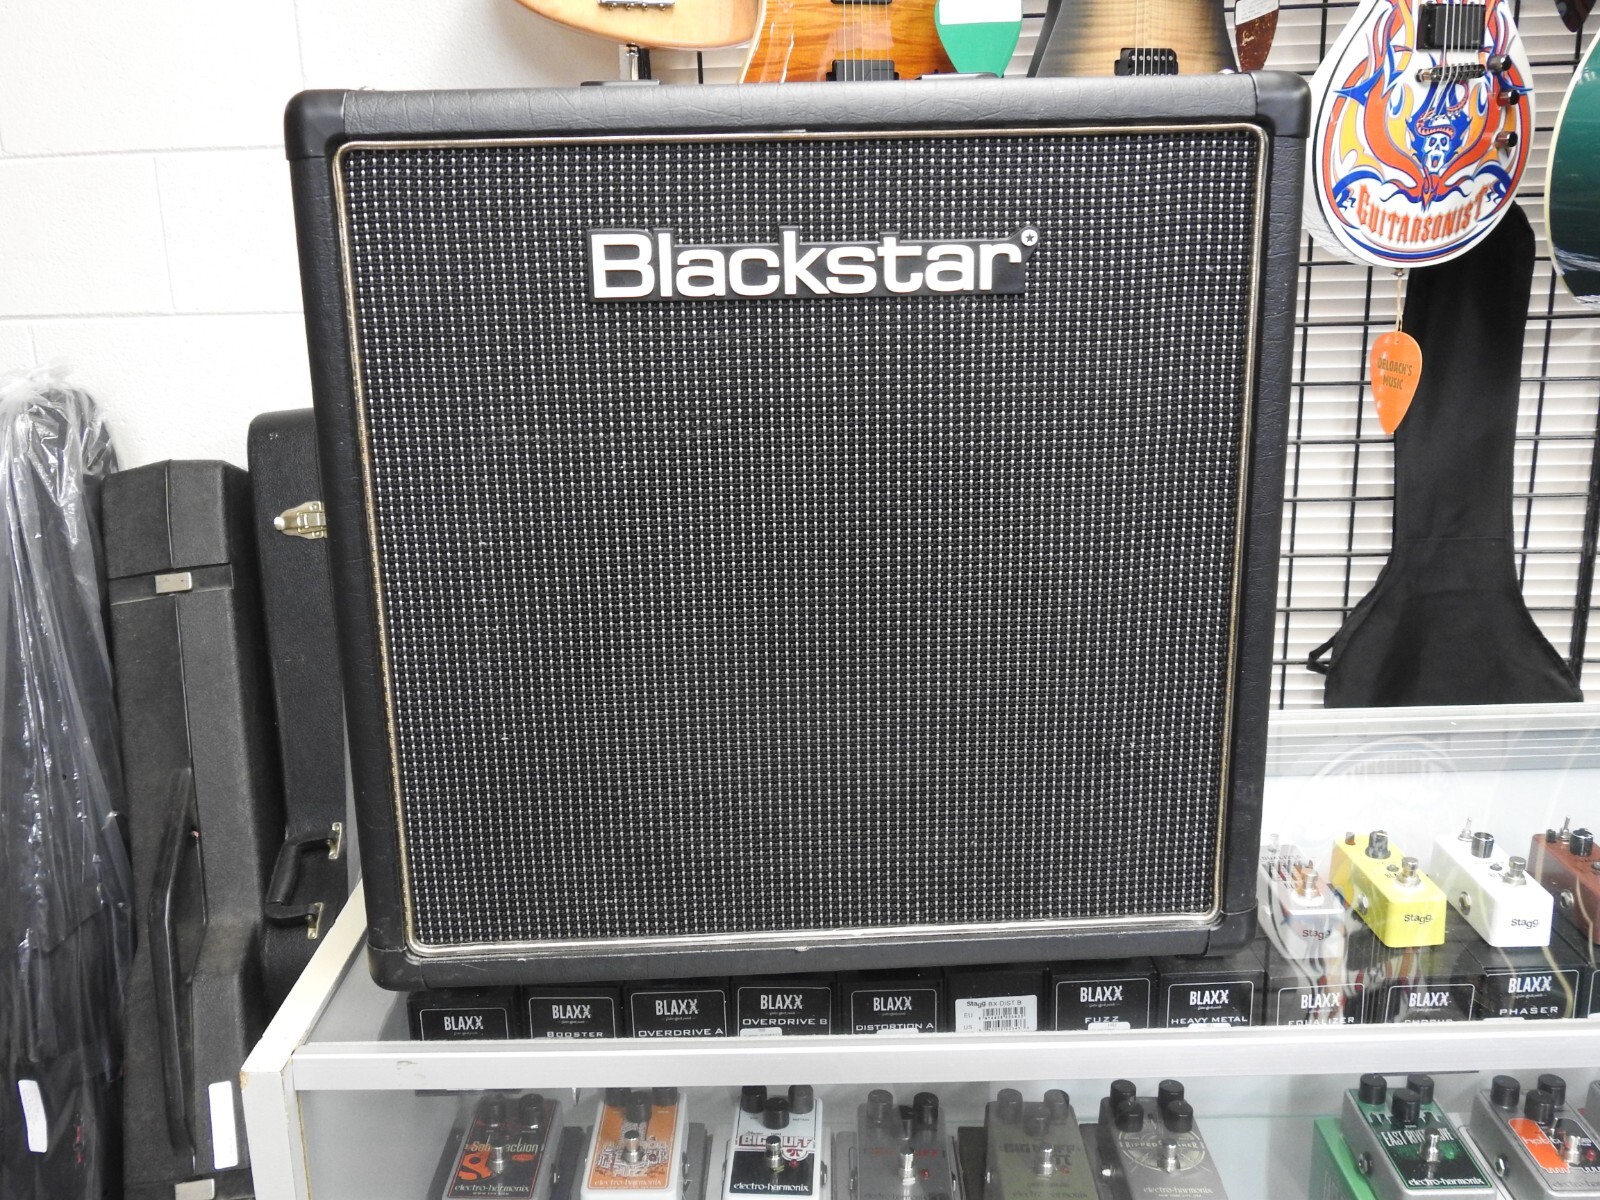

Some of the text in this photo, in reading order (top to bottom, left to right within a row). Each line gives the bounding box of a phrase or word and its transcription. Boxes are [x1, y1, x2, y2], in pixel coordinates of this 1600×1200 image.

[1356, 184, 1488, 243] GUITARSONIST
[591, 231, 1021, 298] Blackstar
[1377, 357, 1412, 376] DELOACH'S
[1382, 374, 1403, 390] MUSIC
[1404, 914, 1432, 924] Stagg
[1511, 919, 1539, 929] Stagg
[1302, 929, 1331, 940] Stagg
[1508, 976, 1552, 993] BLAXX
[1080, 985, 1123, 1002] BLAXX
[1189, 989, 1229, 1005] BLAXX
[1301, 992, 1340, 1009] BLAXX
[1408, 992, 1449, 1007] BLAXX
[655, 999, 699, 1015] BLAXX
[760, 994, 803, 1010] BLAXX
[873, 996, 912, 1011] BLAXX
[552, 1004, 592, 1019] BLAXX
[1499, 1006, 1559, 1015] PHASER
[444, 1016, 484, 1031] BLAXX
[742, 1018, 815, 1026] OVERDRIVE
[855, 1023, 923, 1031] DISTORTION
[638, 1028, 711, 1037] OVERDRIVE
[740, 1135, 813, 1148] BIG UFF
[1381, 1130, 1408, 1147] EAST
[1404, 1129, 1427, 1144] RIVE
[454, 1183, 529, 1192] electro-harmonix
[733, 1182, 809, 1192] electro-harmonix
[1408, 1176, 1485, 1186] electro-harmonix
